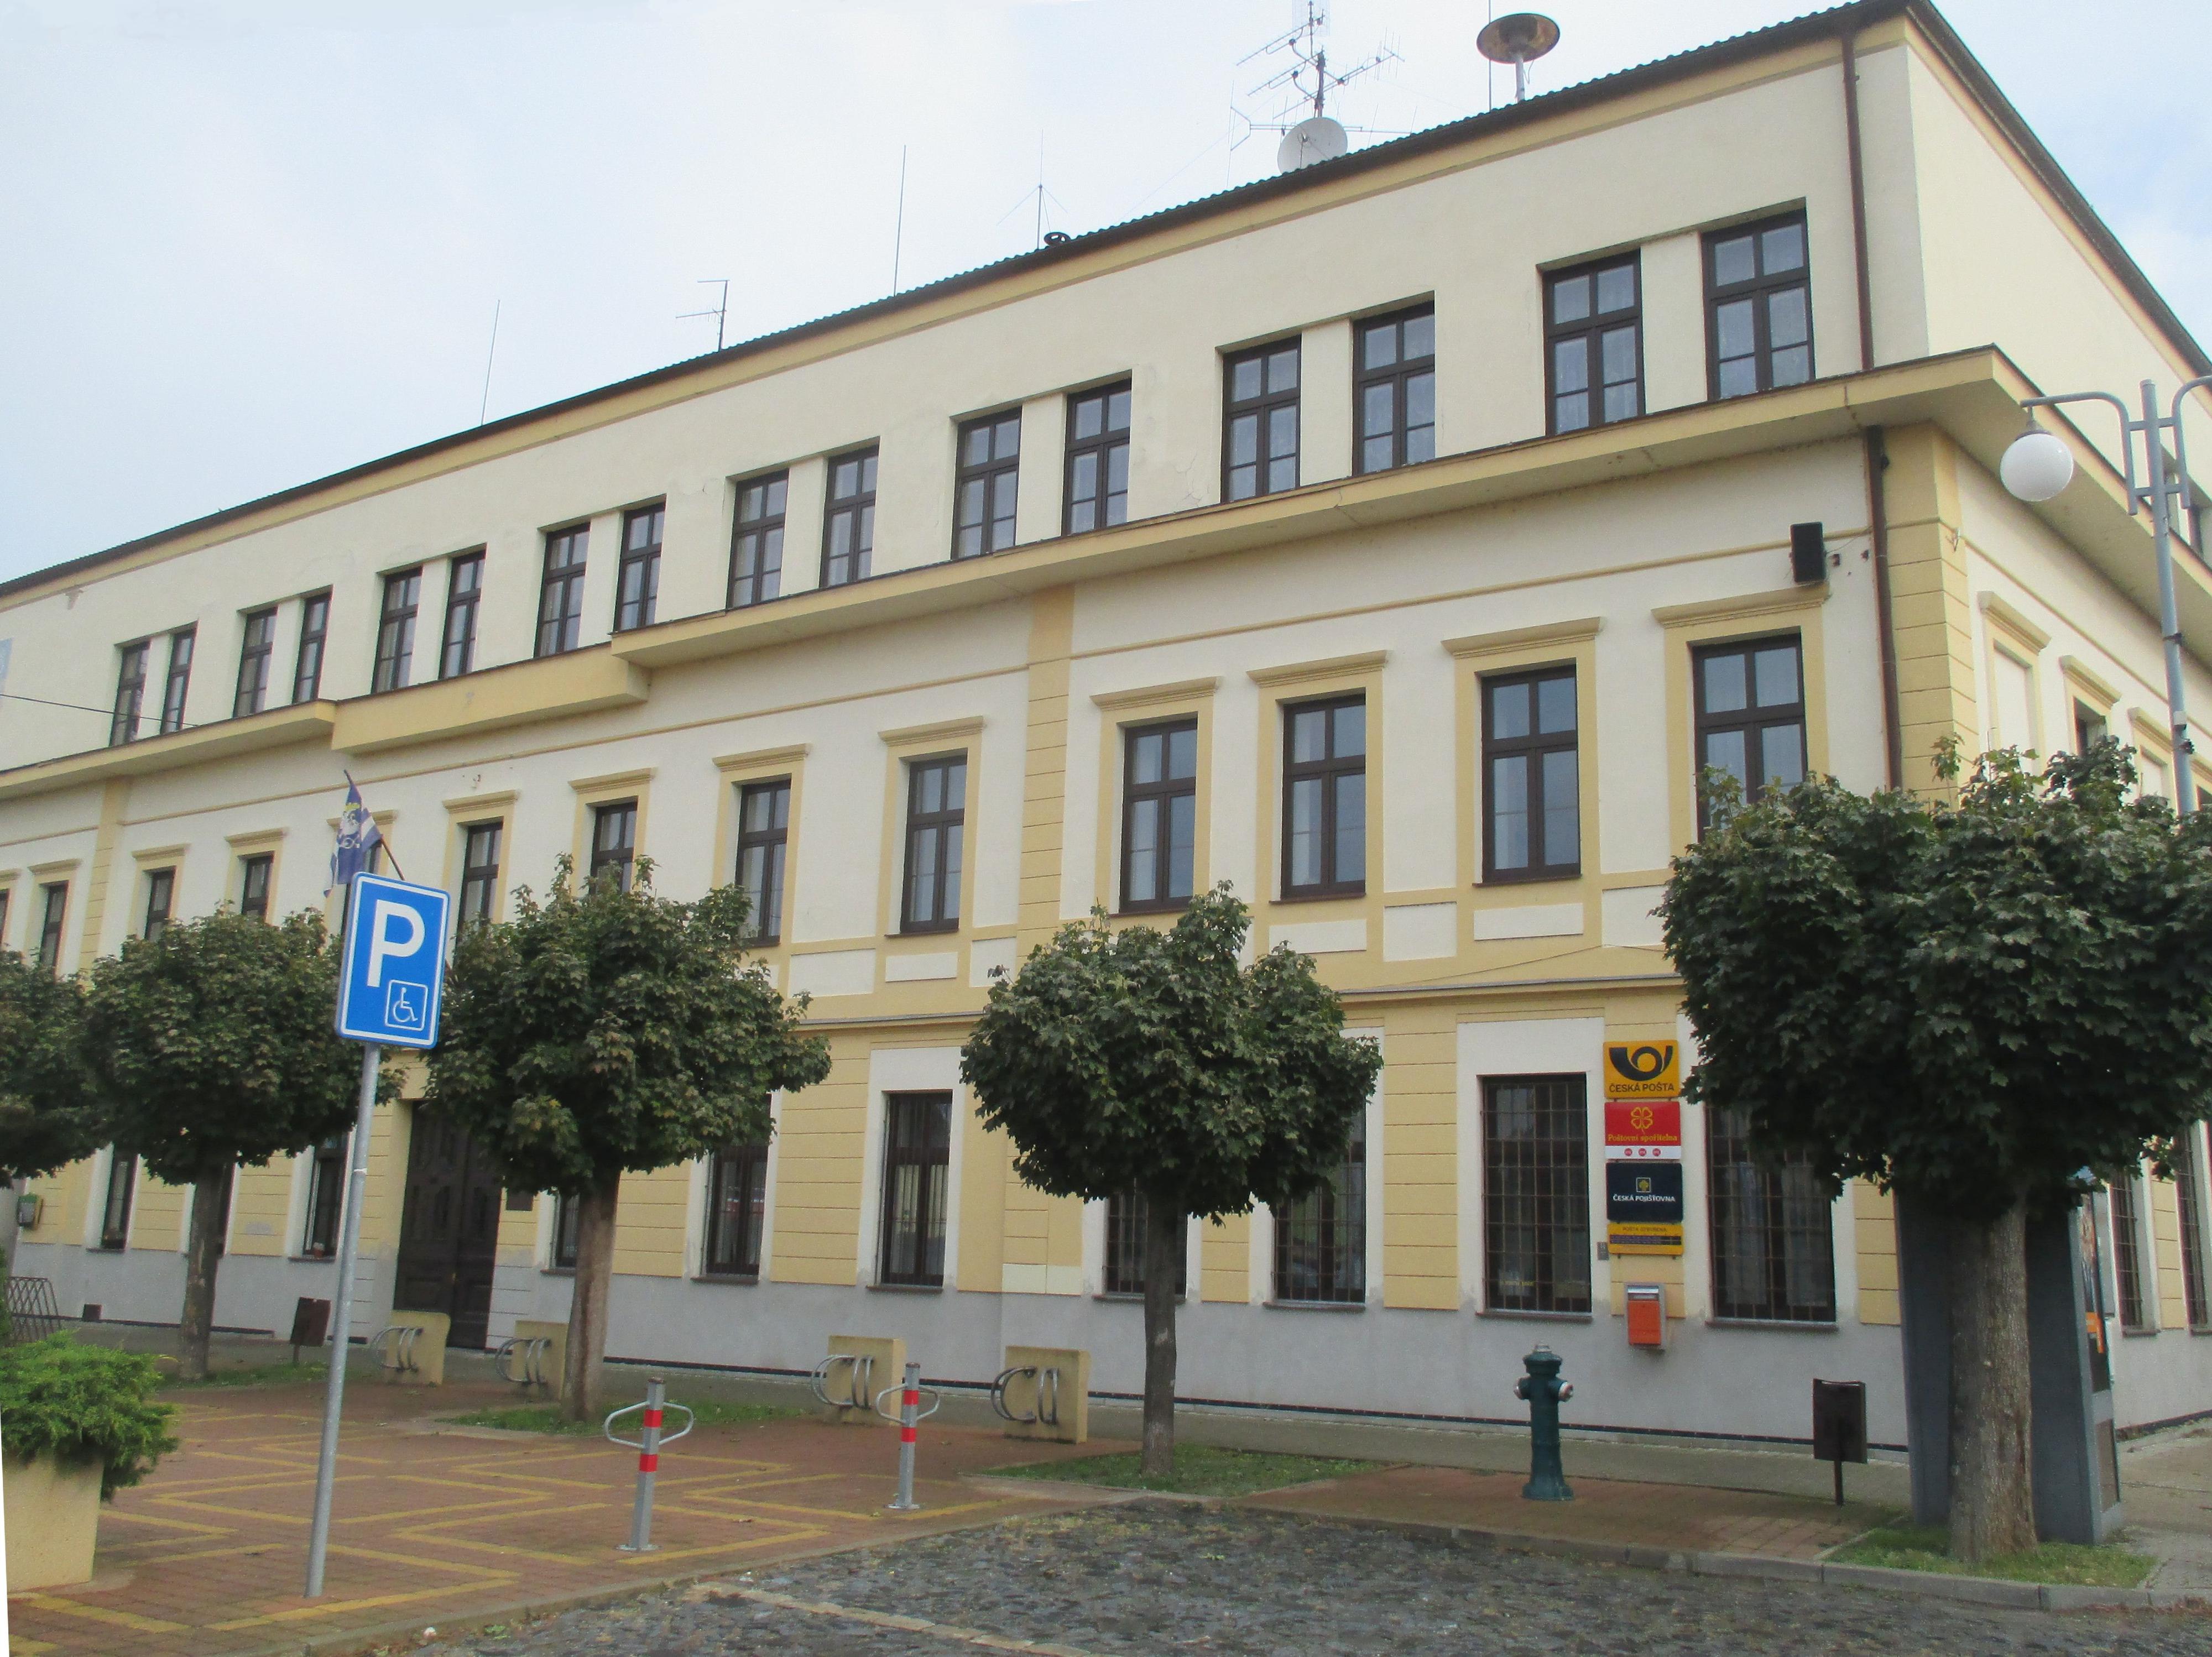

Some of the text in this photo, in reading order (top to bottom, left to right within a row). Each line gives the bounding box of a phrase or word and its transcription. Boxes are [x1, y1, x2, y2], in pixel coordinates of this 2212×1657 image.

[367, 899, 425, 987] P
[1609, 1082, 1674, 1093] ČESKÁ POŠTA
[1640, 1134, 1677, 1142] spořitelna
